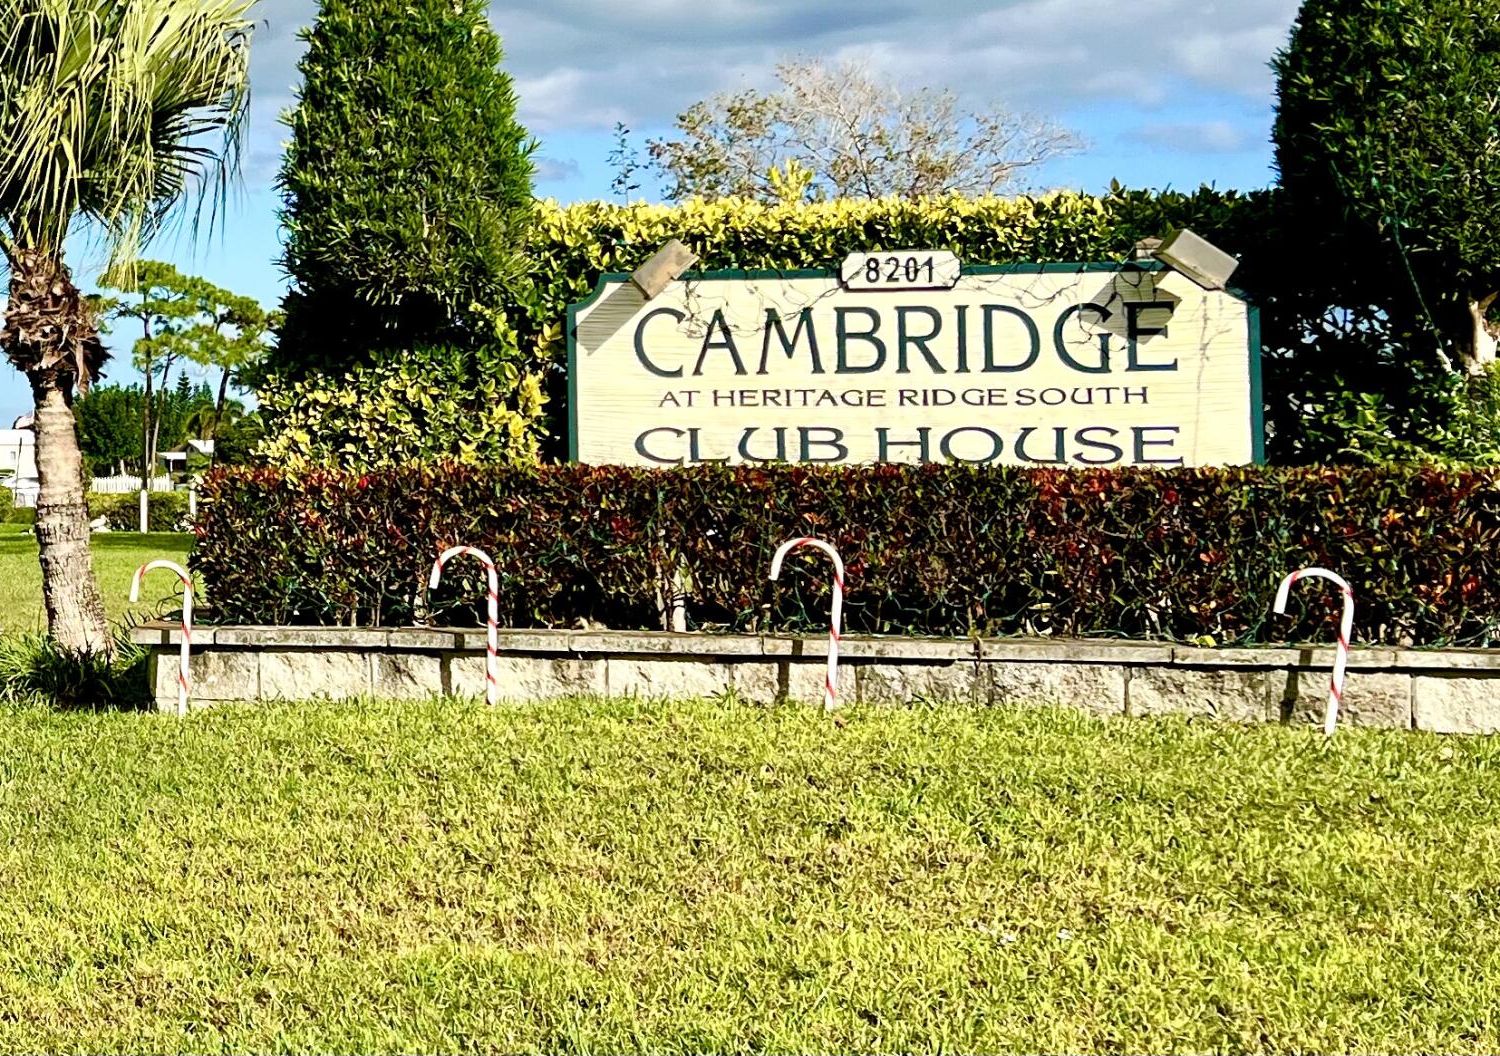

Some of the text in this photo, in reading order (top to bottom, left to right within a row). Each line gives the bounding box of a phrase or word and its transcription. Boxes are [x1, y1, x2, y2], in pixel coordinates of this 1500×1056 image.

[865, 256, 934, 283] 8201
[633, 302, 1179, 378] CAMBRIDGE
[658, 386, 1149, 408] AT HERITAGE RIDGE SOUTH
[633, 426, 1184, 465] CLUB HOUSE
